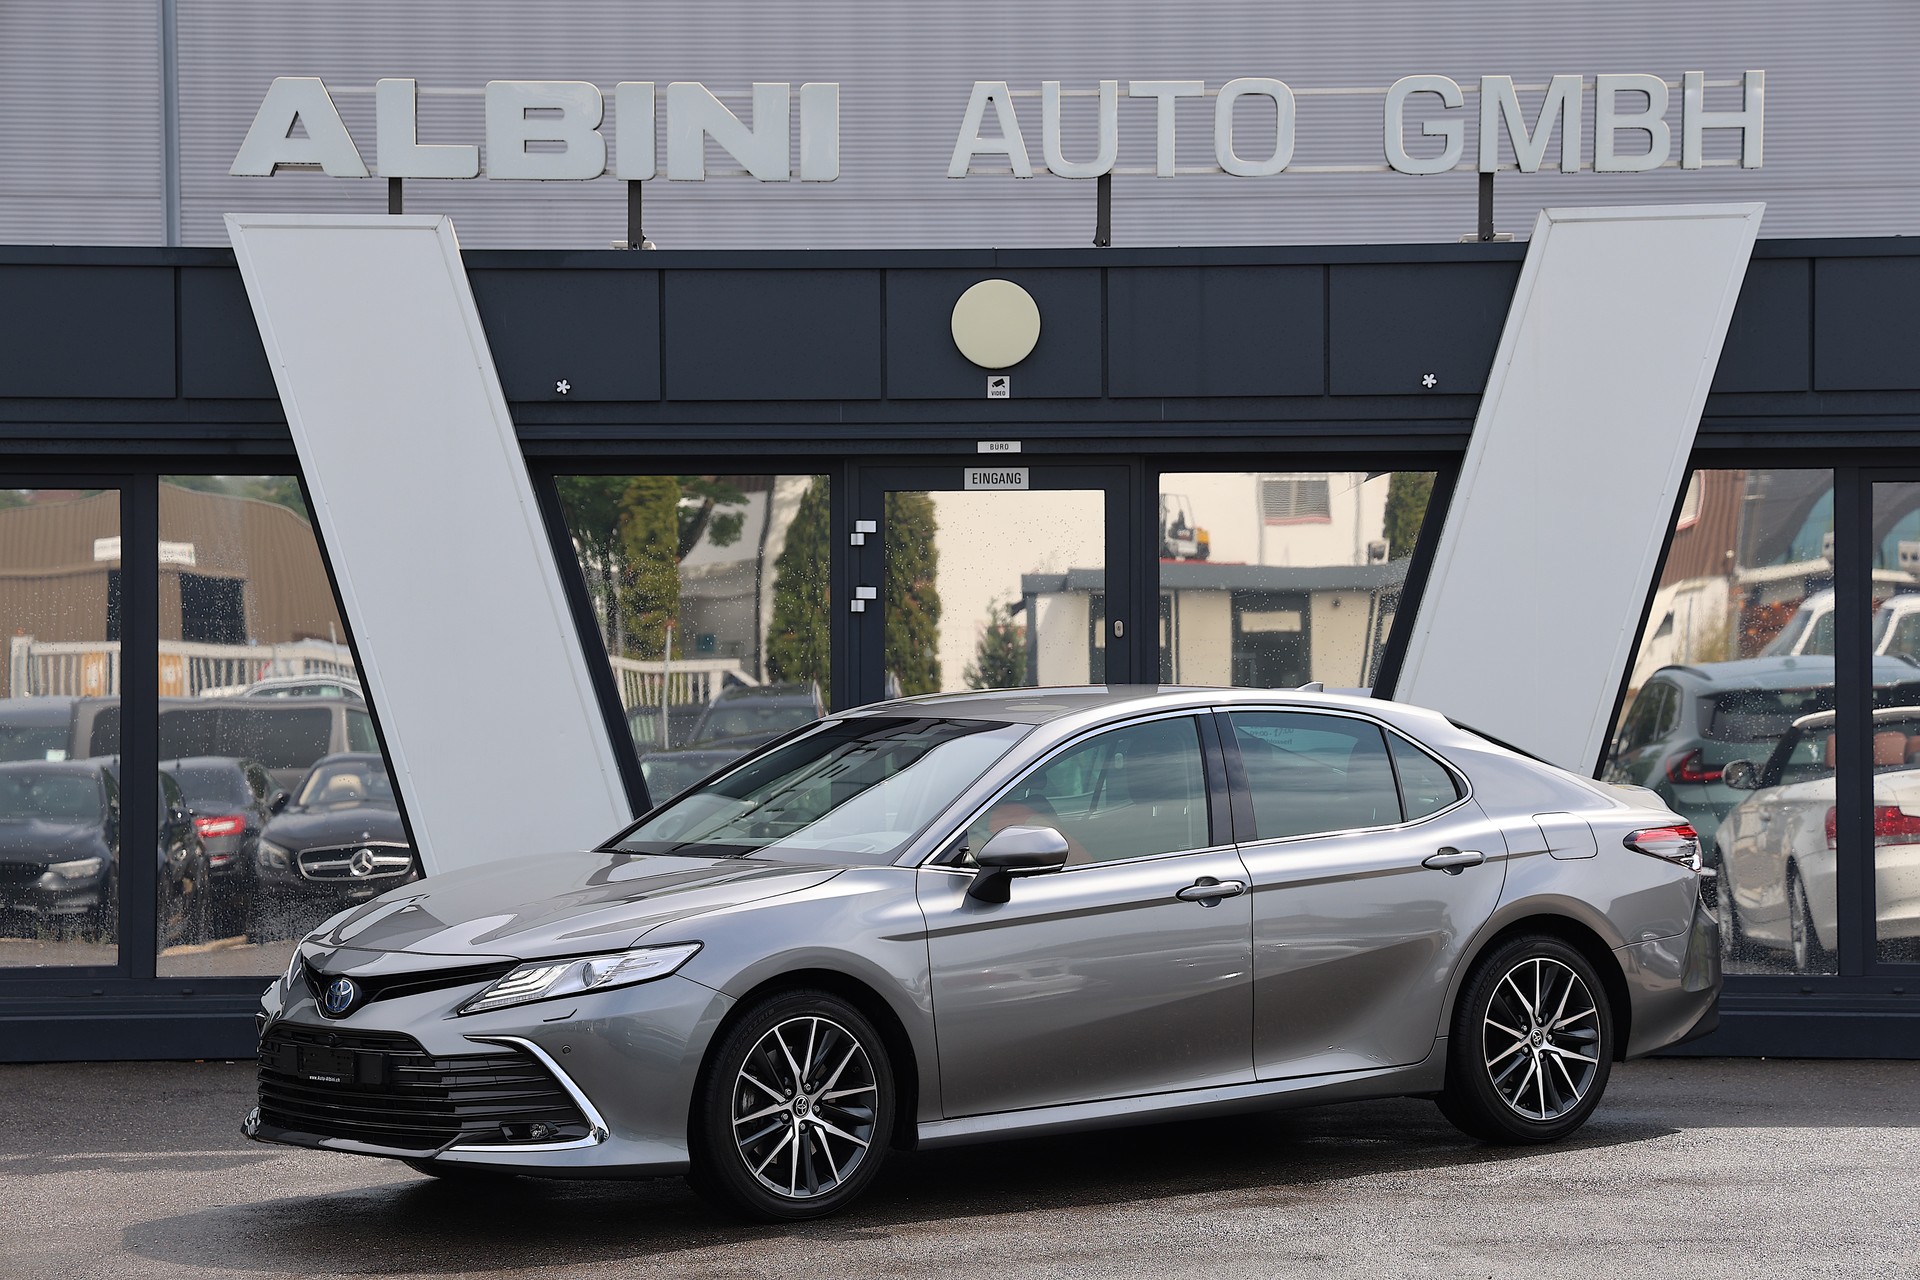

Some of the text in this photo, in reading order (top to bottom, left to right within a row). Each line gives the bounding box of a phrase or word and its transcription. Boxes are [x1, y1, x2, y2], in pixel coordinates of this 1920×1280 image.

[228, 69, 1765, 182] ALBINI AUTO GMBH
[989, 443, 1009, 451] BÜRO
[972, 472, 1022, 485] EINGANG
